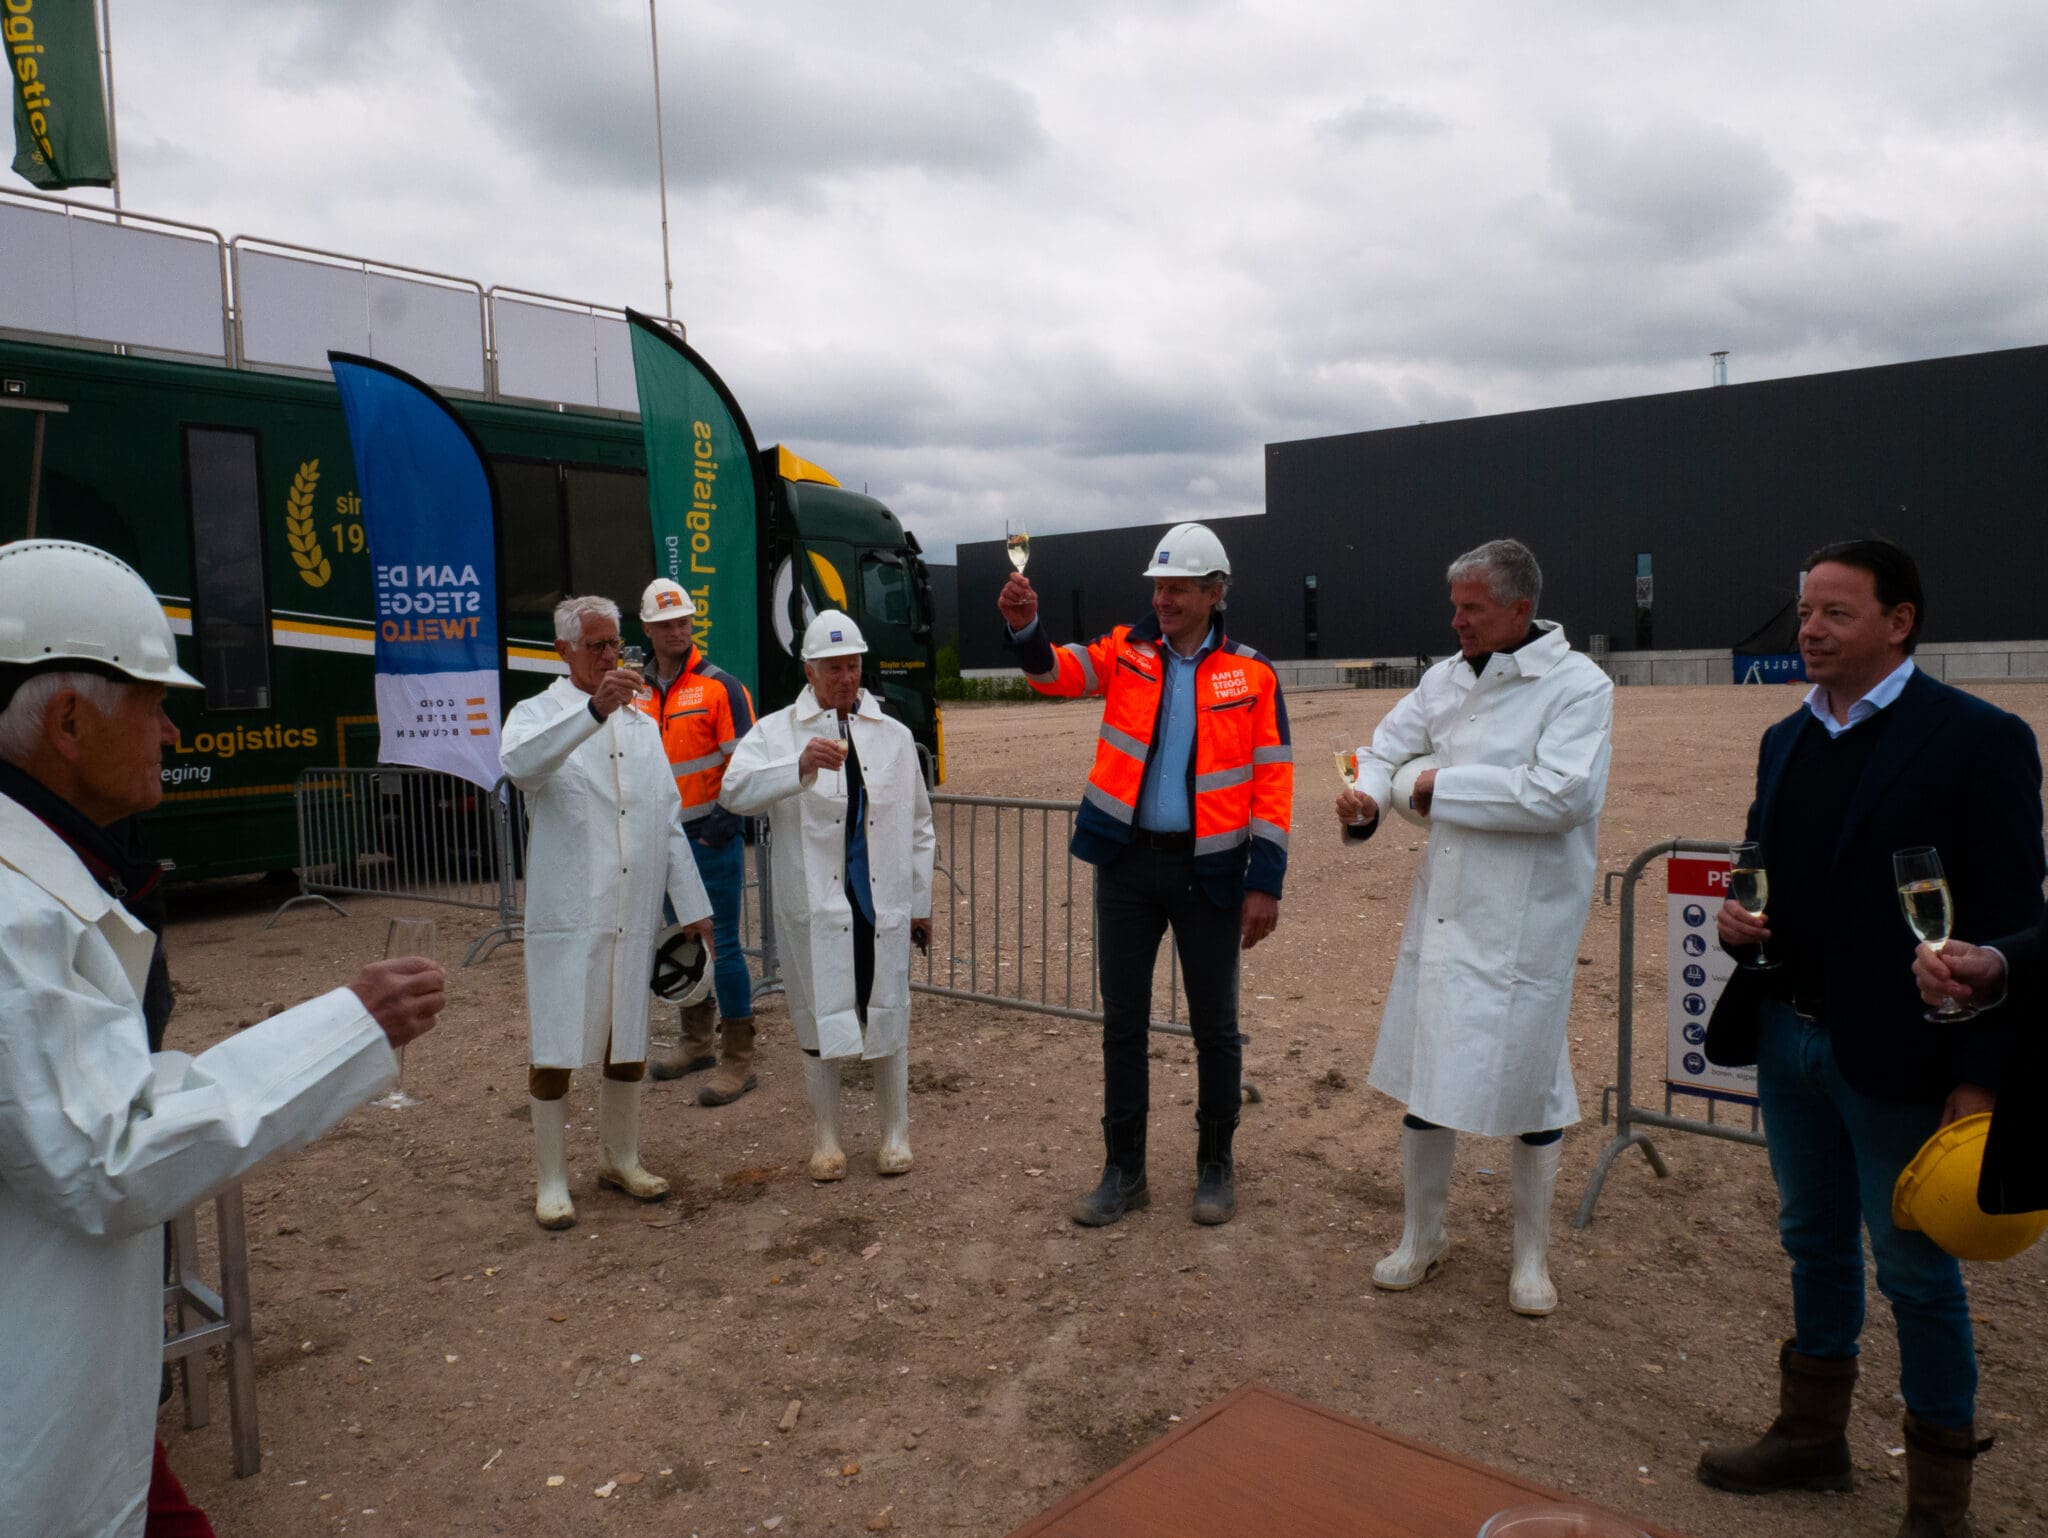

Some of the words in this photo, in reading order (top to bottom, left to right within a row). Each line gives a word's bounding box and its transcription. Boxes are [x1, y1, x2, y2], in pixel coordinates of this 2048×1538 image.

[3, 0, 53, 159] ogistic
[330, 523, 369, 554] 19
[1211, 671, 1231, 682] AAN
[1232, 669, 1245, 678] DE
[1213, 678, 1247, 690] STEGGE
[1215, 686, 1249, 699] TWELLO
[174, 723, 318, 759] Logistics
[160, 763, 212, 785] eging
